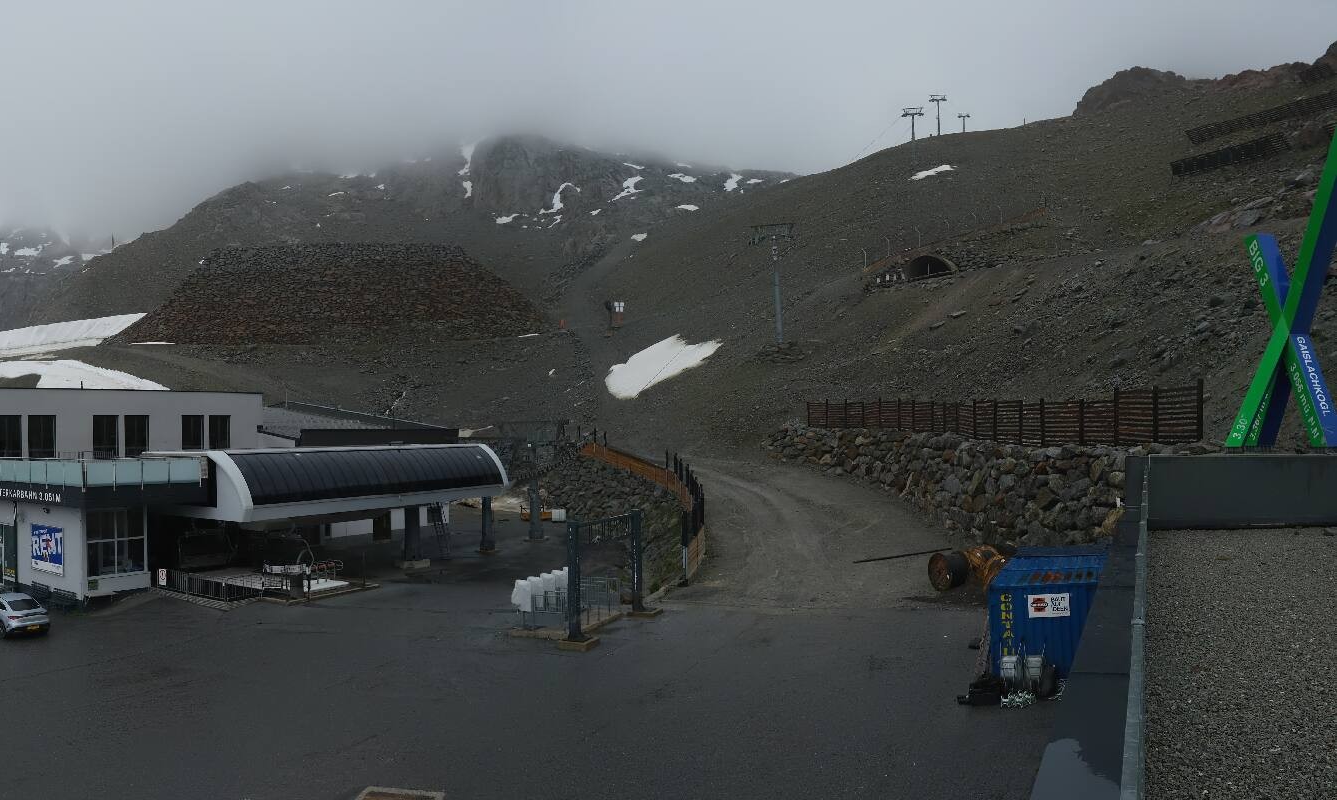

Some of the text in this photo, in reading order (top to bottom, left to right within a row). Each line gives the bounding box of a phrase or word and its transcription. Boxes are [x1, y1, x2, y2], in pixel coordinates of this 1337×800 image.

[1248, 239, 1269, 287] BIG 3
[1296, 336, 1331, 417] GAISLACHKOGL
[1232, 415, 1248, 440] 3.30
